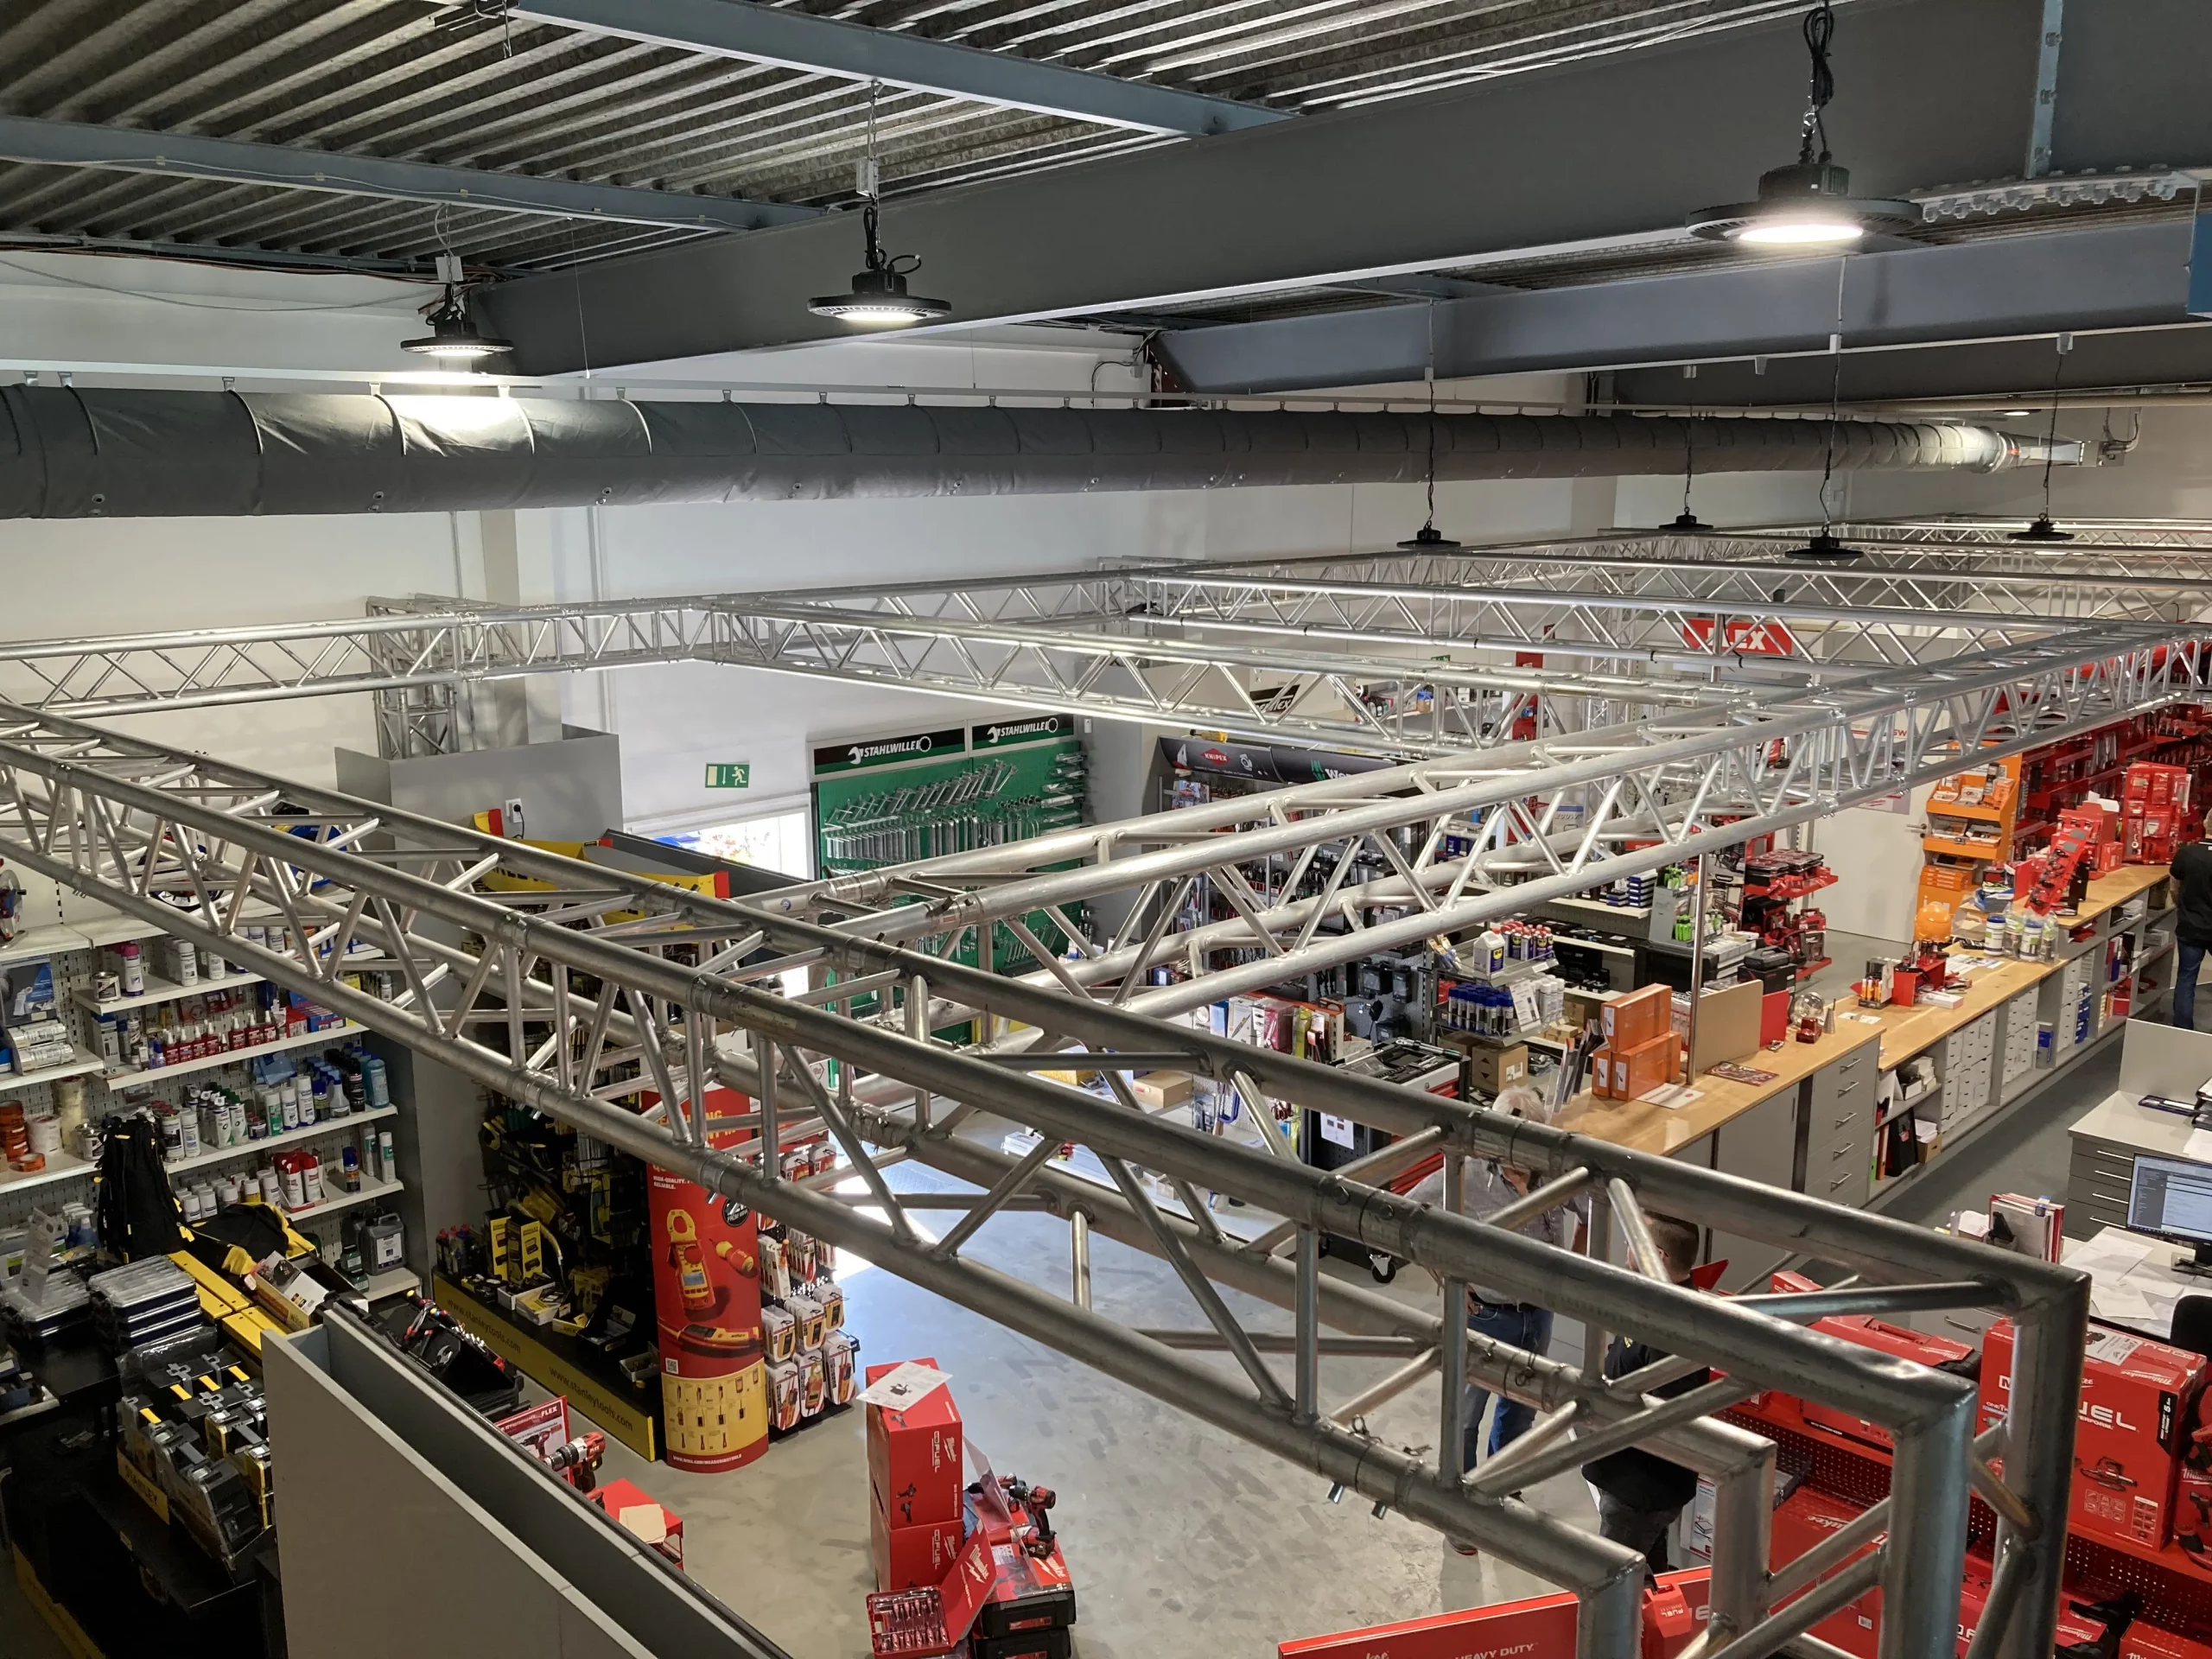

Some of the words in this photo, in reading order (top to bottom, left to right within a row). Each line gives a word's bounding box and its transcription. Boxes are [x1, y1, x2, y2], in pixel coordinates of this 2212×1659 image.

[1001, 722, 1046, 737] STAHLWILLE
[863, 740, 918, 758] STAHLWILLE
[1204, 753, 1228, 762] KNIPEX
[447, 1299, 522, 1354] www.stanleytools.com
[550, 1366, 632, 1432] www.stanleytools.com
[541, 1406, 558, 1417] FLEX
